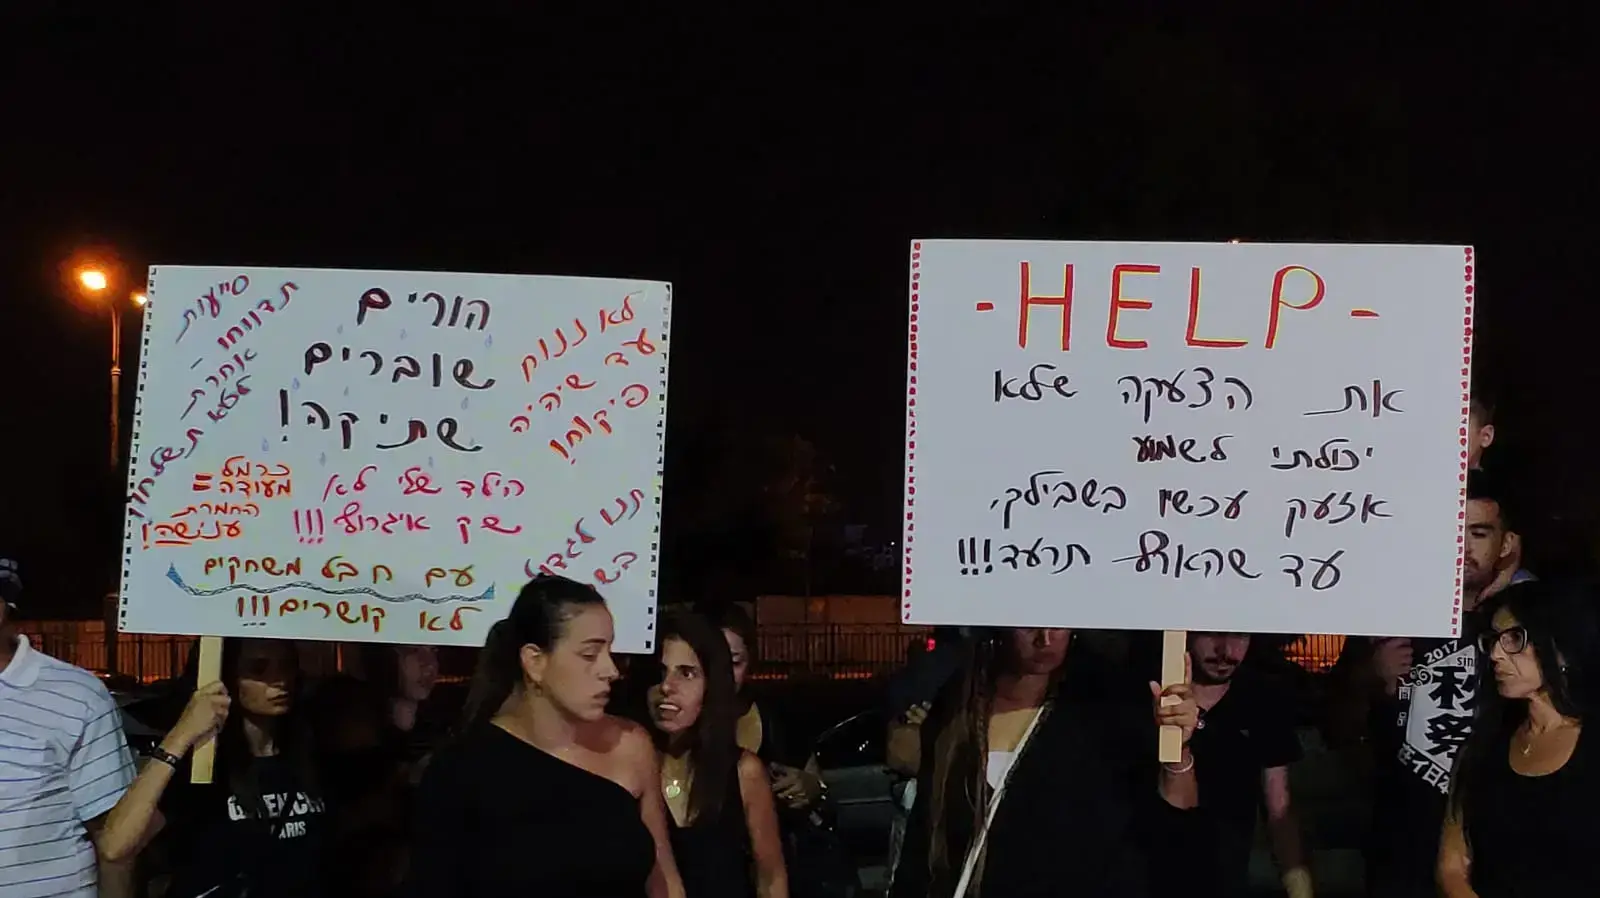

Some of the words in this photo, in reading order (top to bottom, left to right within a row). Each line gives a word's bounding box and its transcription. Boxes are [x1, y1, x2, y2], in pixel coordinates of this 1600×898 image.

[356, 287, 490, 331] הורים
[600, 290, 643, 333] לא
[303, 341, 496, 390] שוברים
[520, 317, 588, 383] ננוח
[604, 327, 656, 366] עד
[180, 348, 258, 421] אחרת
[993, 363, 1079, 403] שלא
[1117, 366, 1253, 425] הצעקה
[1303, 379, 1404, 418] את
[509, 373, 598, 433] שיהיה
[221, 455, 291, 478] כרמל
[1131, 434, 1235, 463] לשמוע
[1270, 438, 1374, 471] יכולתי
[321, 465, 378, 502] לא
[398, 466, 443, 496] שלי
[456, 472, 525, 499] הילד
[600, 488, 645, 526] תנו
[1284, 491, 1393, 538] אזעק
[456, 515, 523, 545] שק
[204, 555, 301, 584] משחקים
[1111, 529, 1263, 579] שהארץ
[1279, 549, 1345, 590] עד
[424, 563, 475, 588] עם
[419, 605, 483, 632] לא
[1423, 639, 1459, 665] 2017
